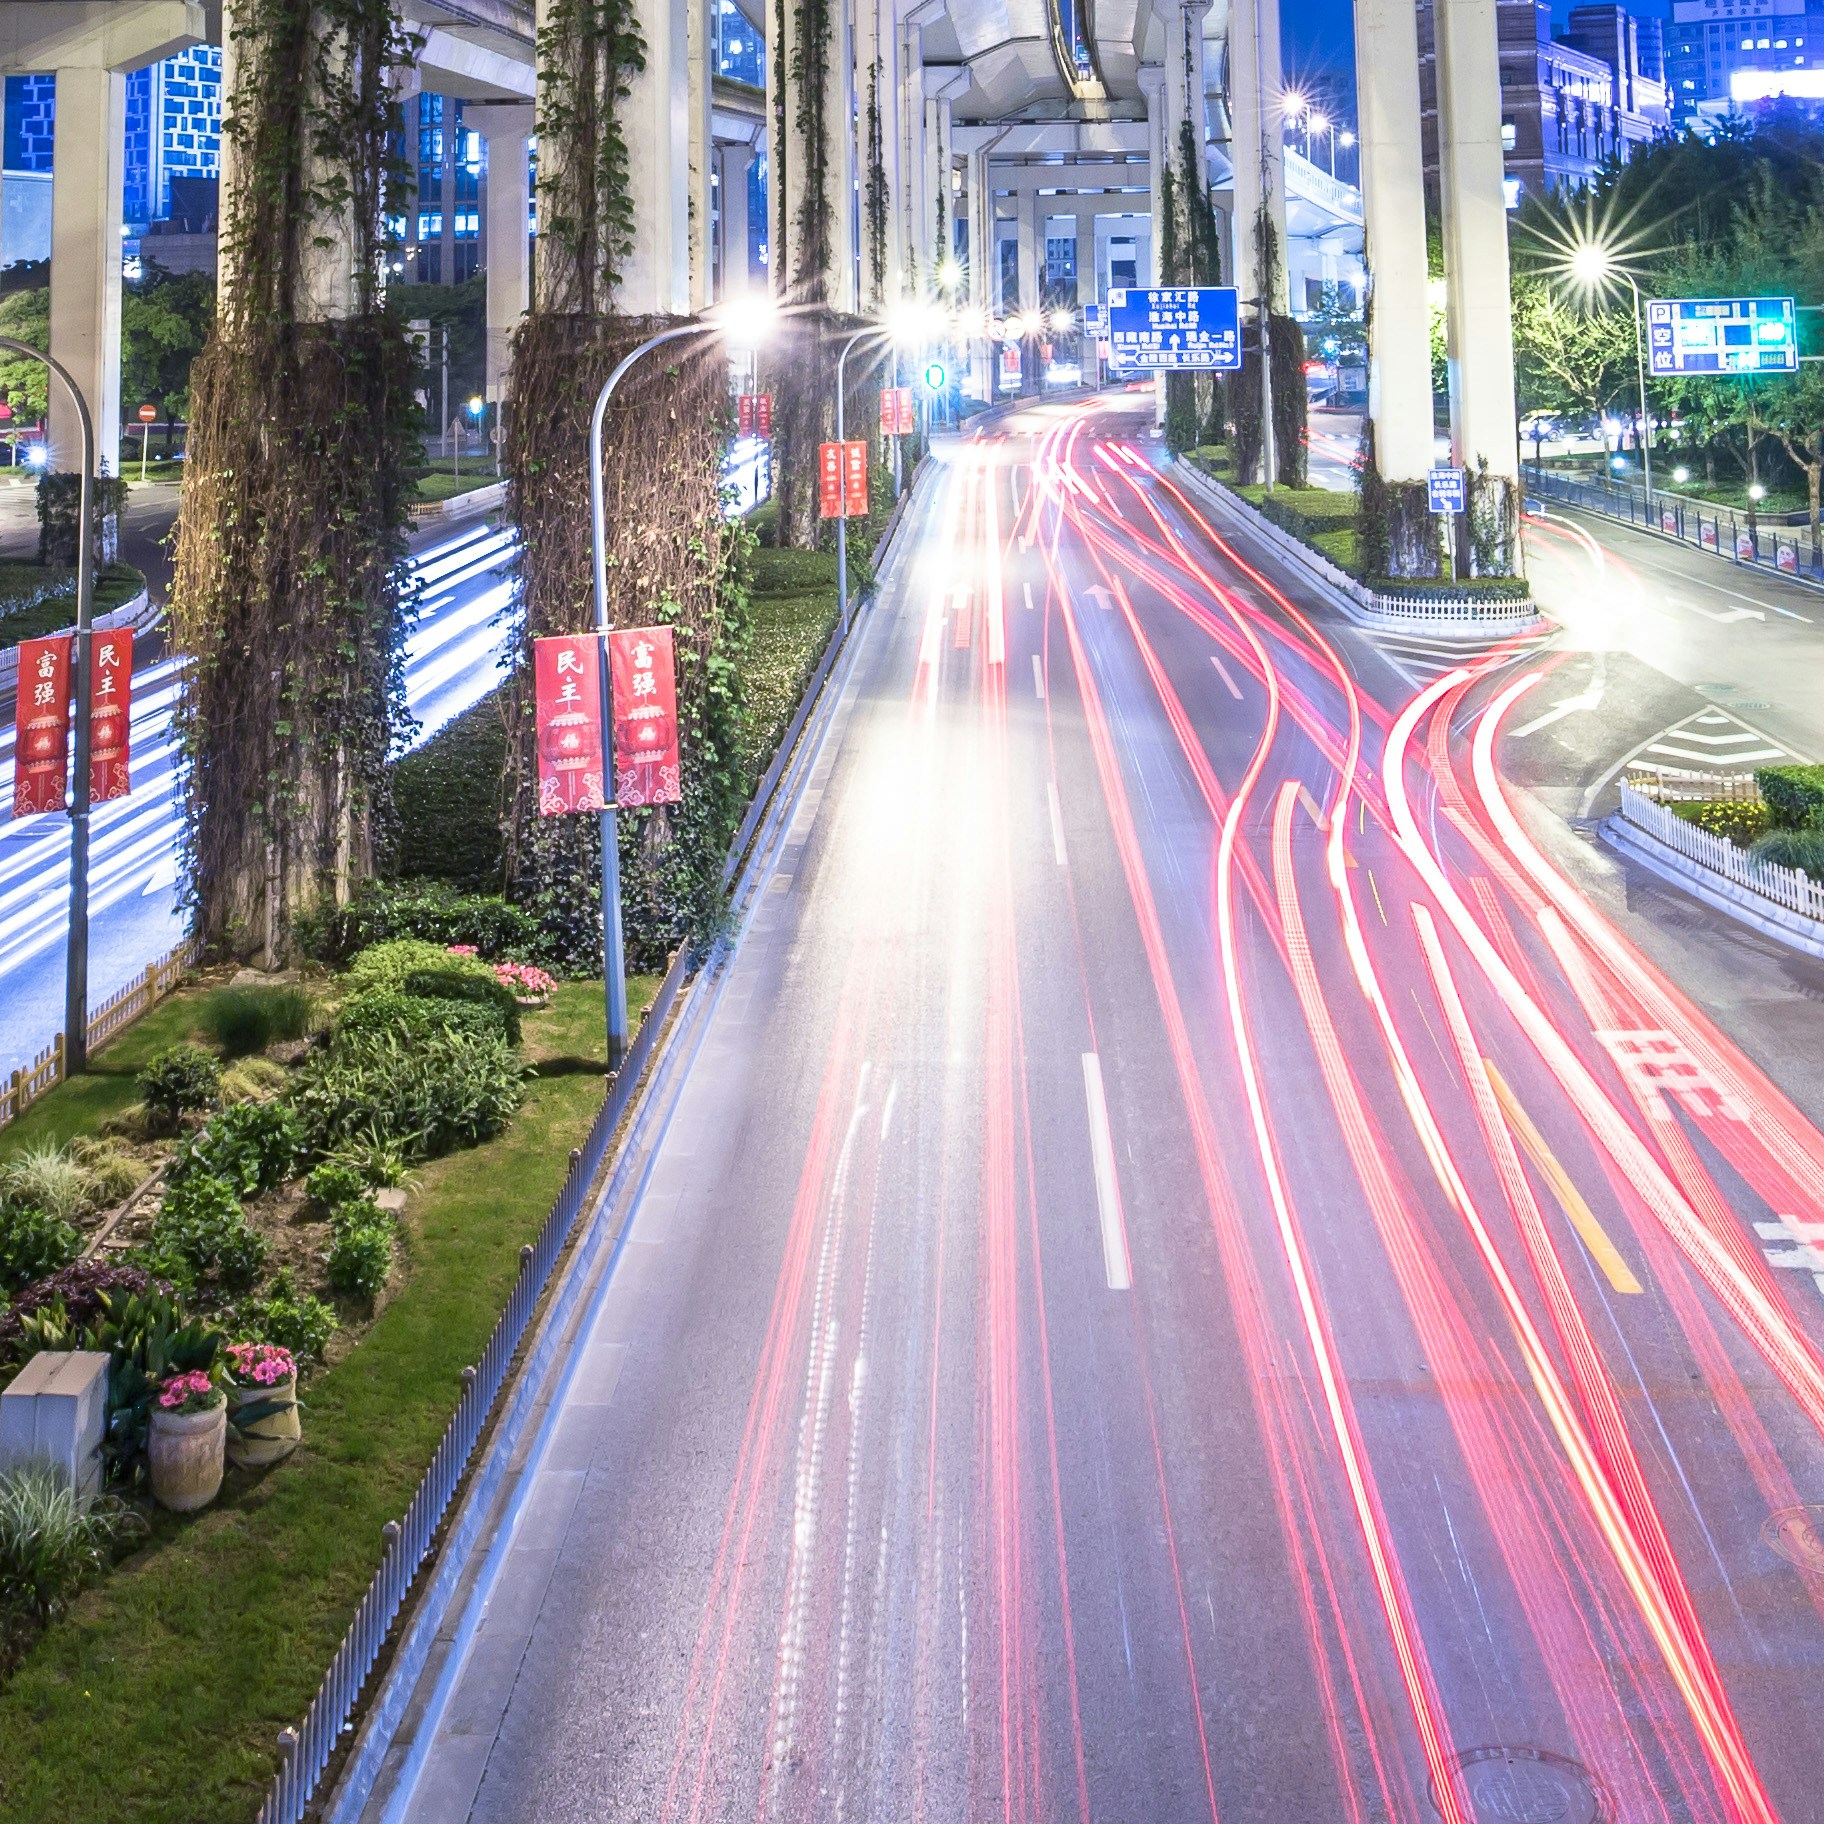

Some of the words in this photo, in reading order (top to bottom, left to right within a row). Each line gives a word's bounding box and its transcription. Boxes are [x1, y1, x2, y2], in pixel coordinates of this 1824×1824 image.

[33, 650, 58, 706] 富强
[95, 643, 120, 696] 民主
[555, 649, 584, 704] 民主
[630, 640, 657, 697] 富强
